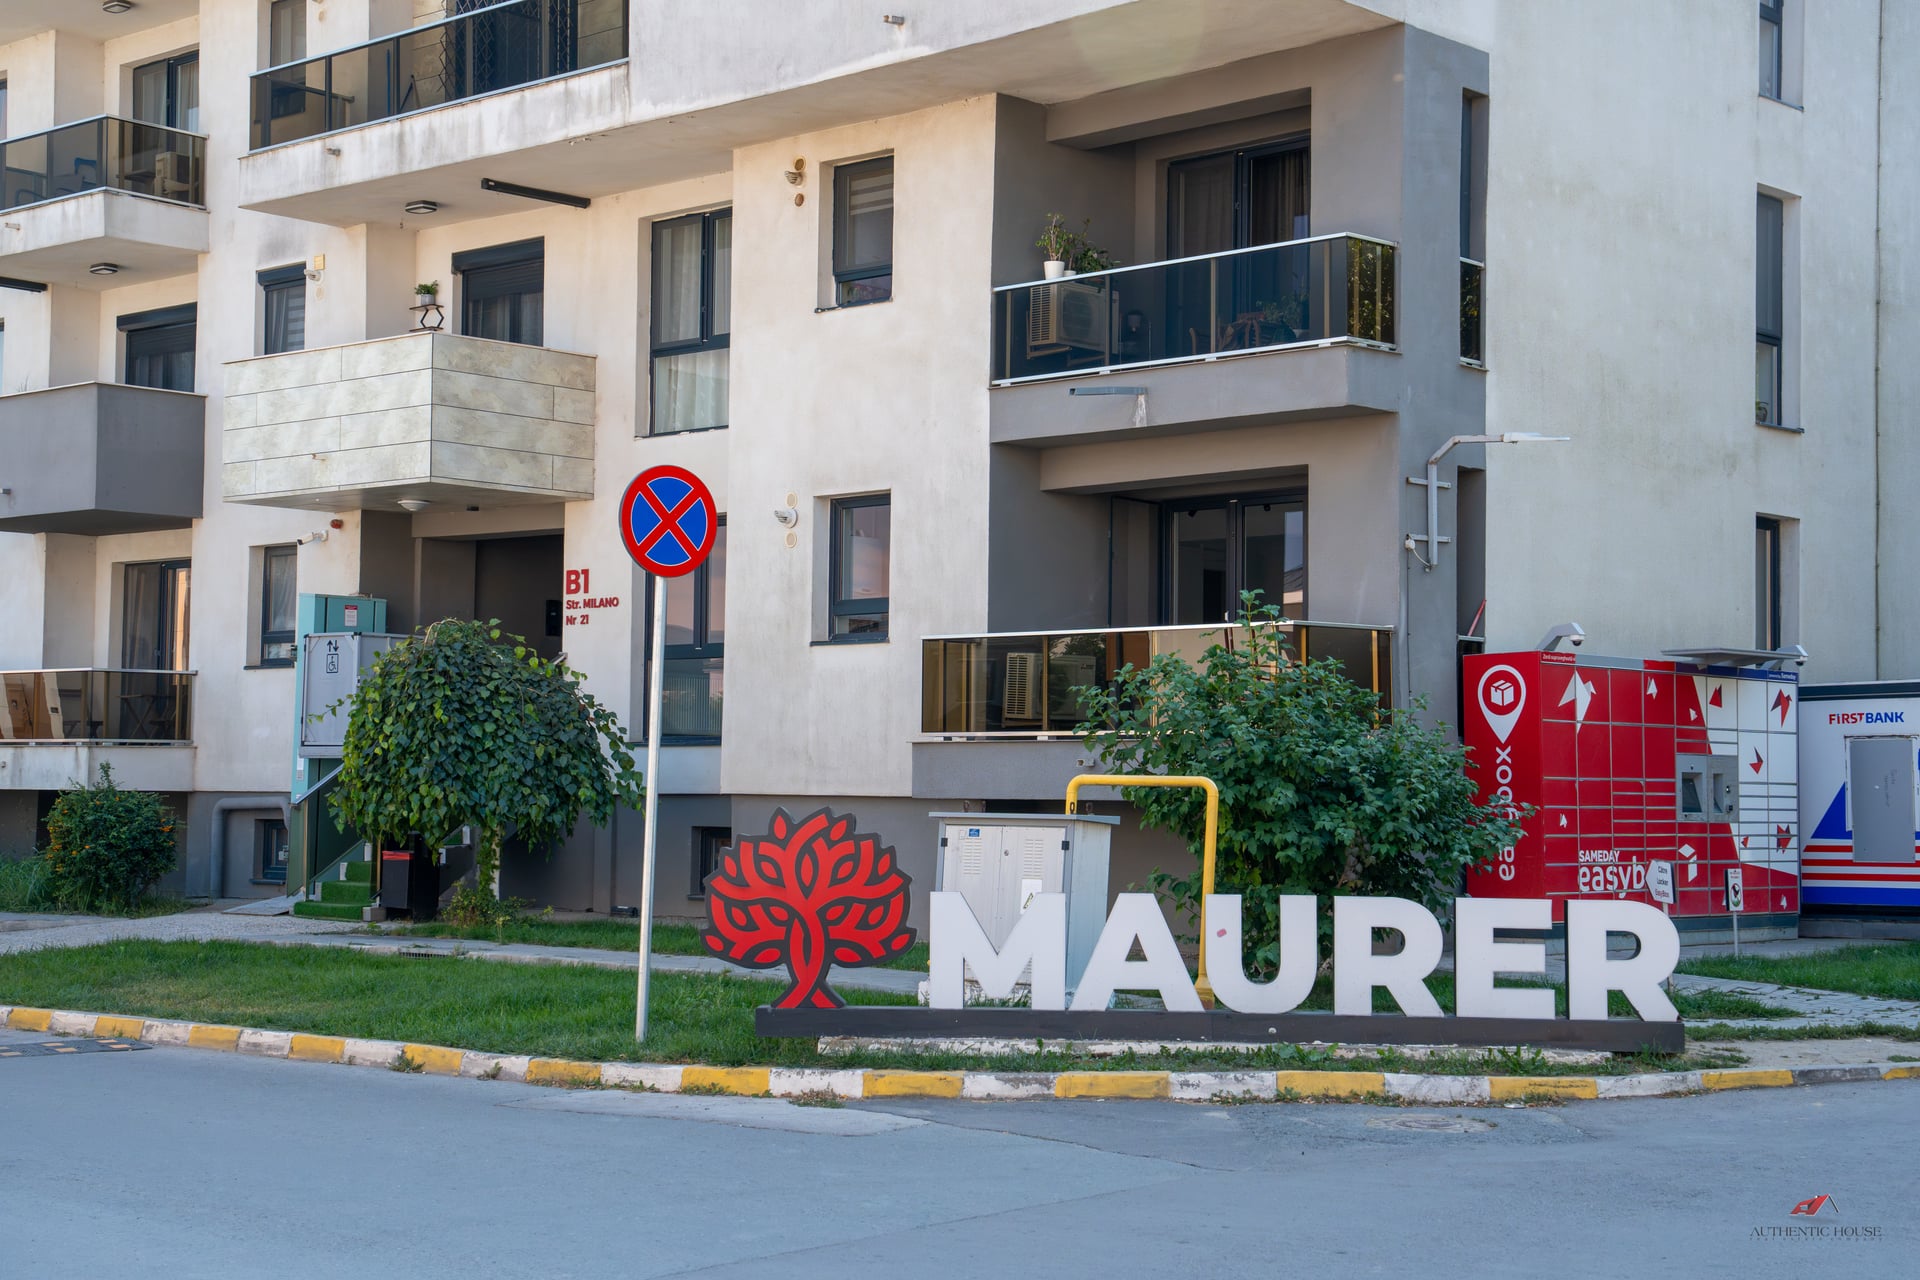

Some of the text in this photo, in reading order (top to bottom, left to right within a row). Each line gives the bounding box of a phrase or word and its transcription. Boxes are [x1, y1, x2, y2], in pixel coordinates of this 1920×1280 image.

[566, 569, 589, 594] B1
[566, 597, 619, 610] Str. MILANO
[580, 614, 589, 624] 21
[1495, 745, 1519, 881] eabox
[1579, 850, 1620, 862] SAMEDAY
[1578, 856, 1645, 899] easyb
[930, 891, 1681, 1021] MAURER
